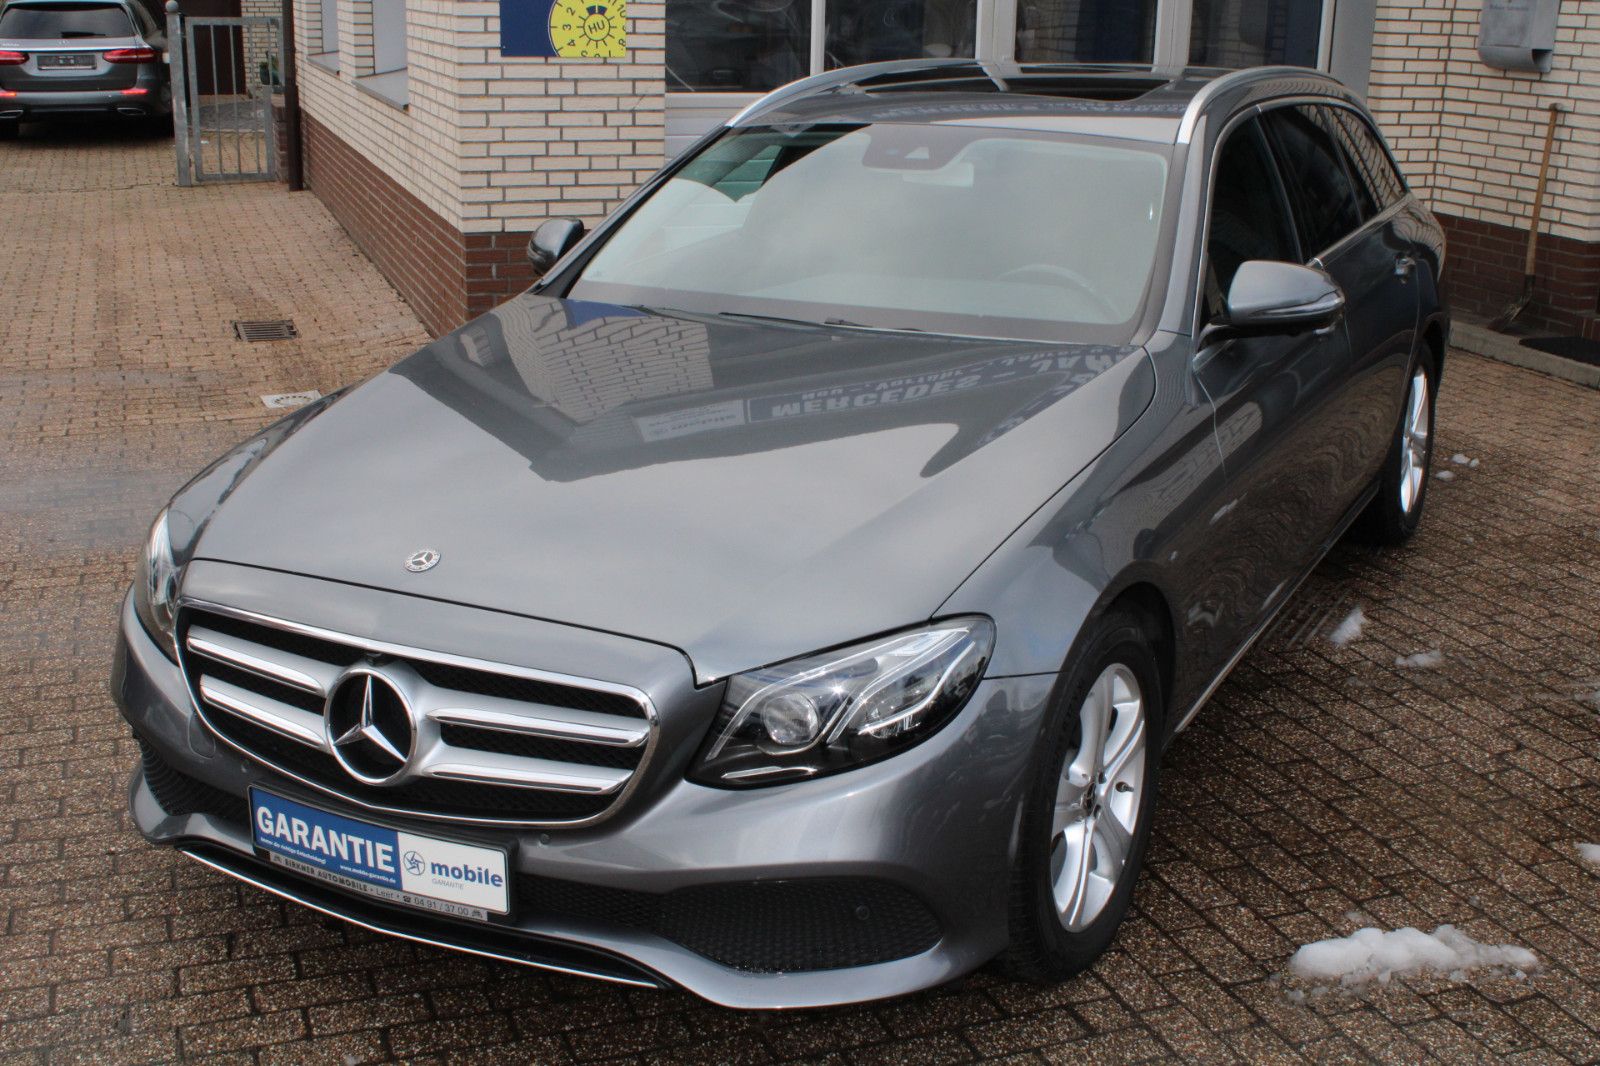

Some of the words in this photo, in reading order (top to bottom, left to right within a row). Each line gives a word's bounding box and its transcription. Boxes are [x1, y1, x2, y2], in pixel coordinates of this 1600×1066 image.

[566, 7, 576, 16] 2
[588, 20, 605, 34] HU
[567, 39, 576, 47] 4
[256, 806, 395, 873] GARANTIE
[431, 861, 503, 887] mobile
[432, 878, 464, 890] GARANTIE
[318, 871, 368, 892] AUTOMOBILE
[414, 896, 425, 905] 04
[445, 903, 455, 913] 37
[457, 906, 469, 916] 00
